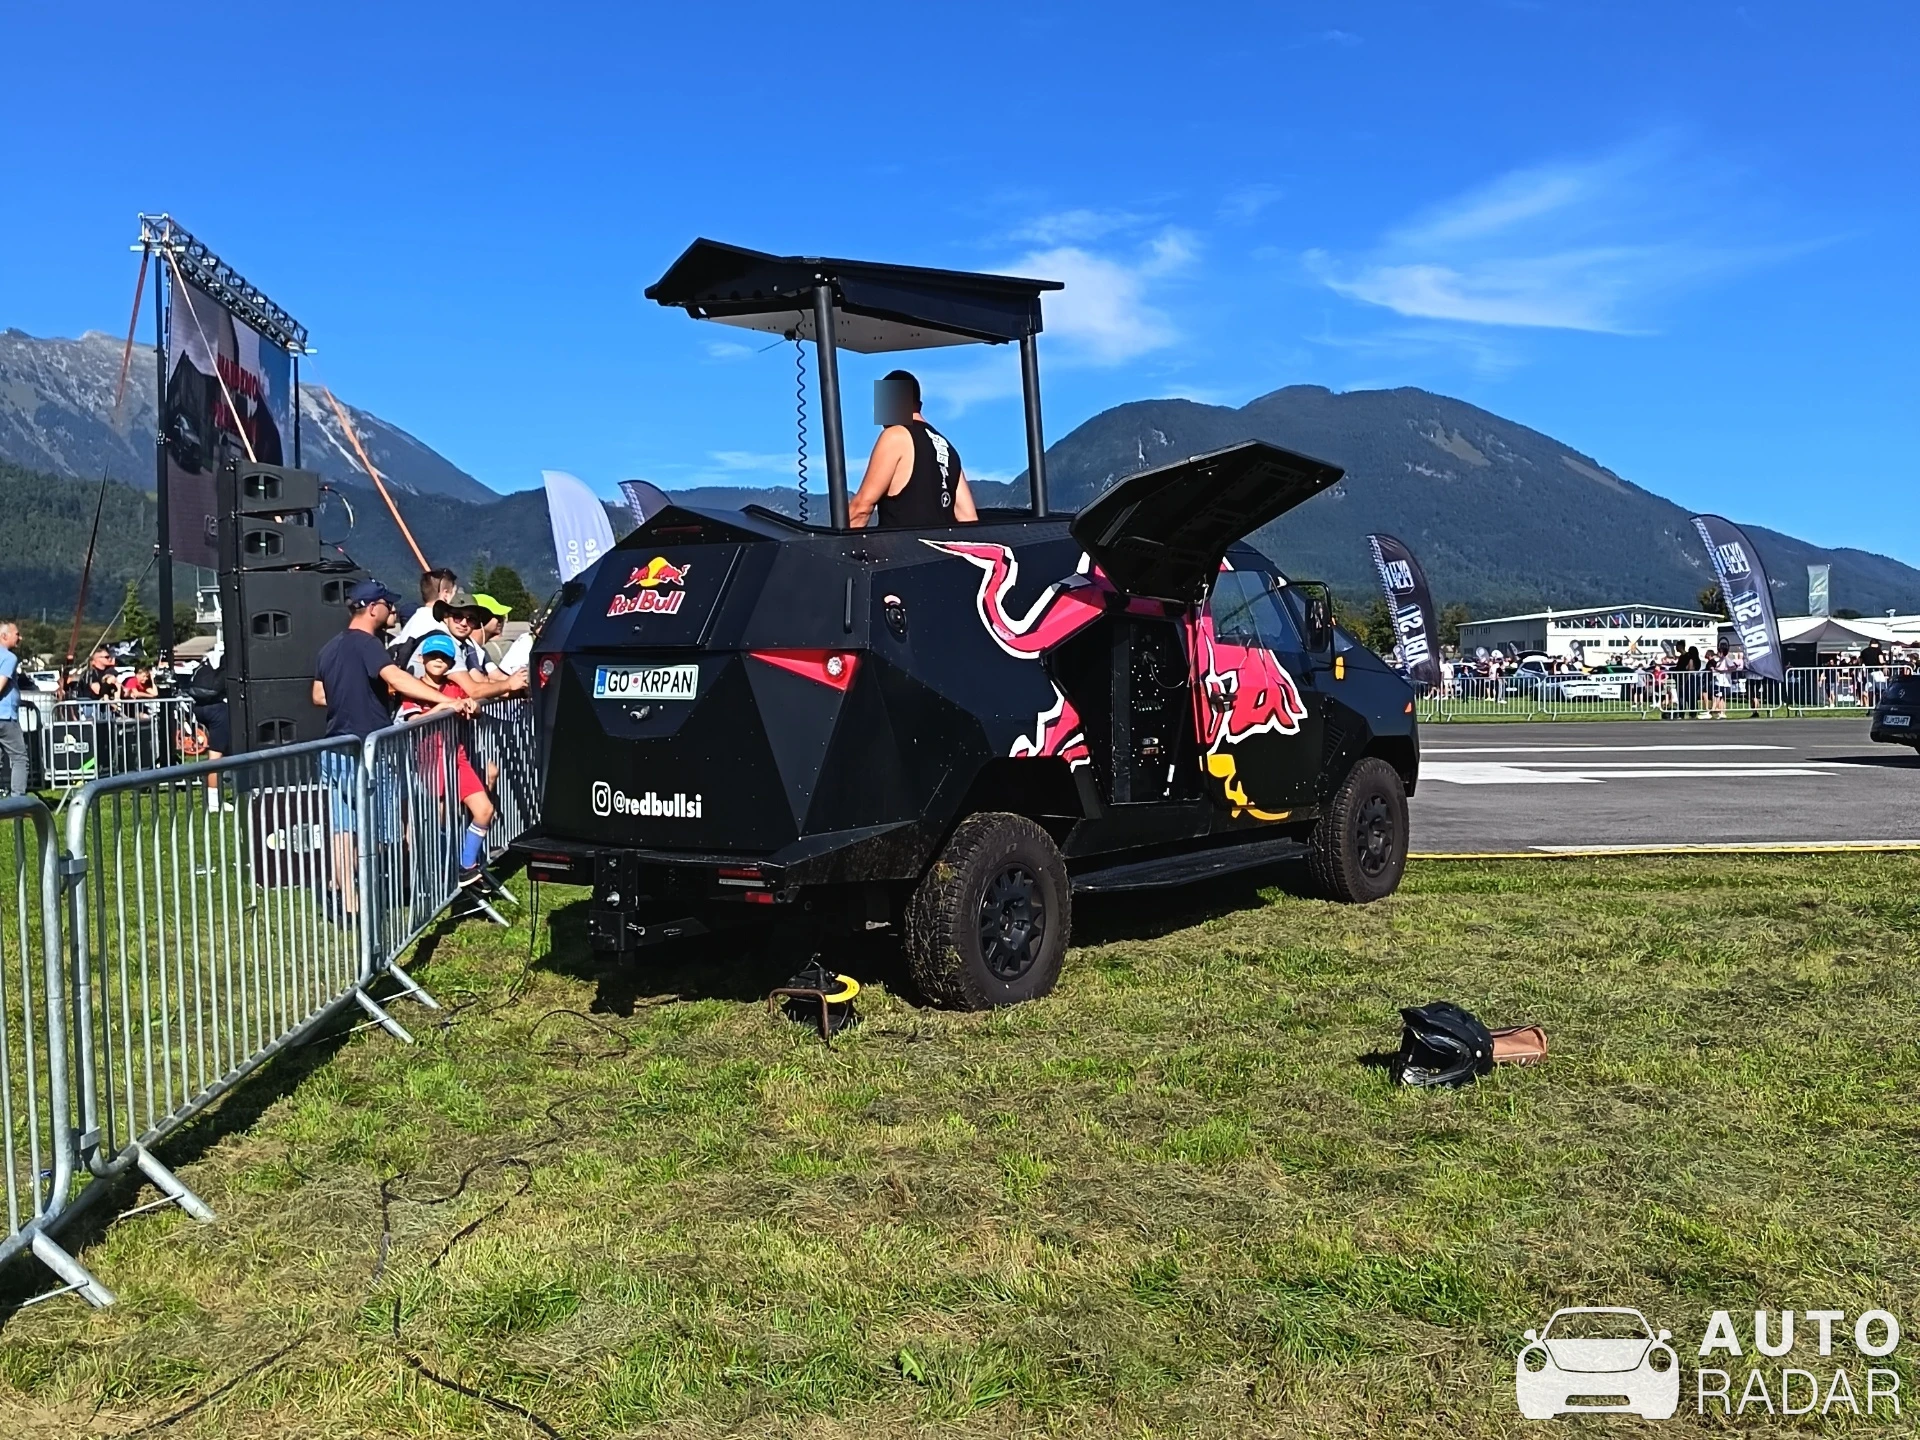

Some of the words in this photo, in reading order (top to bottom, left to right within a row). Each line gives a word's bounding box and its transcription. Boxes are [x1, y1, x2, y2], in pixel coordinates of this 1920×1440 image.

[606, 588, 642, 617] Red
[639, 589, 686, 615] Bull
[608, 670, 630, 692] GO
[640, 670, 693, 693] KRPAN
[613, 790, 702, 819] @redbullsi
